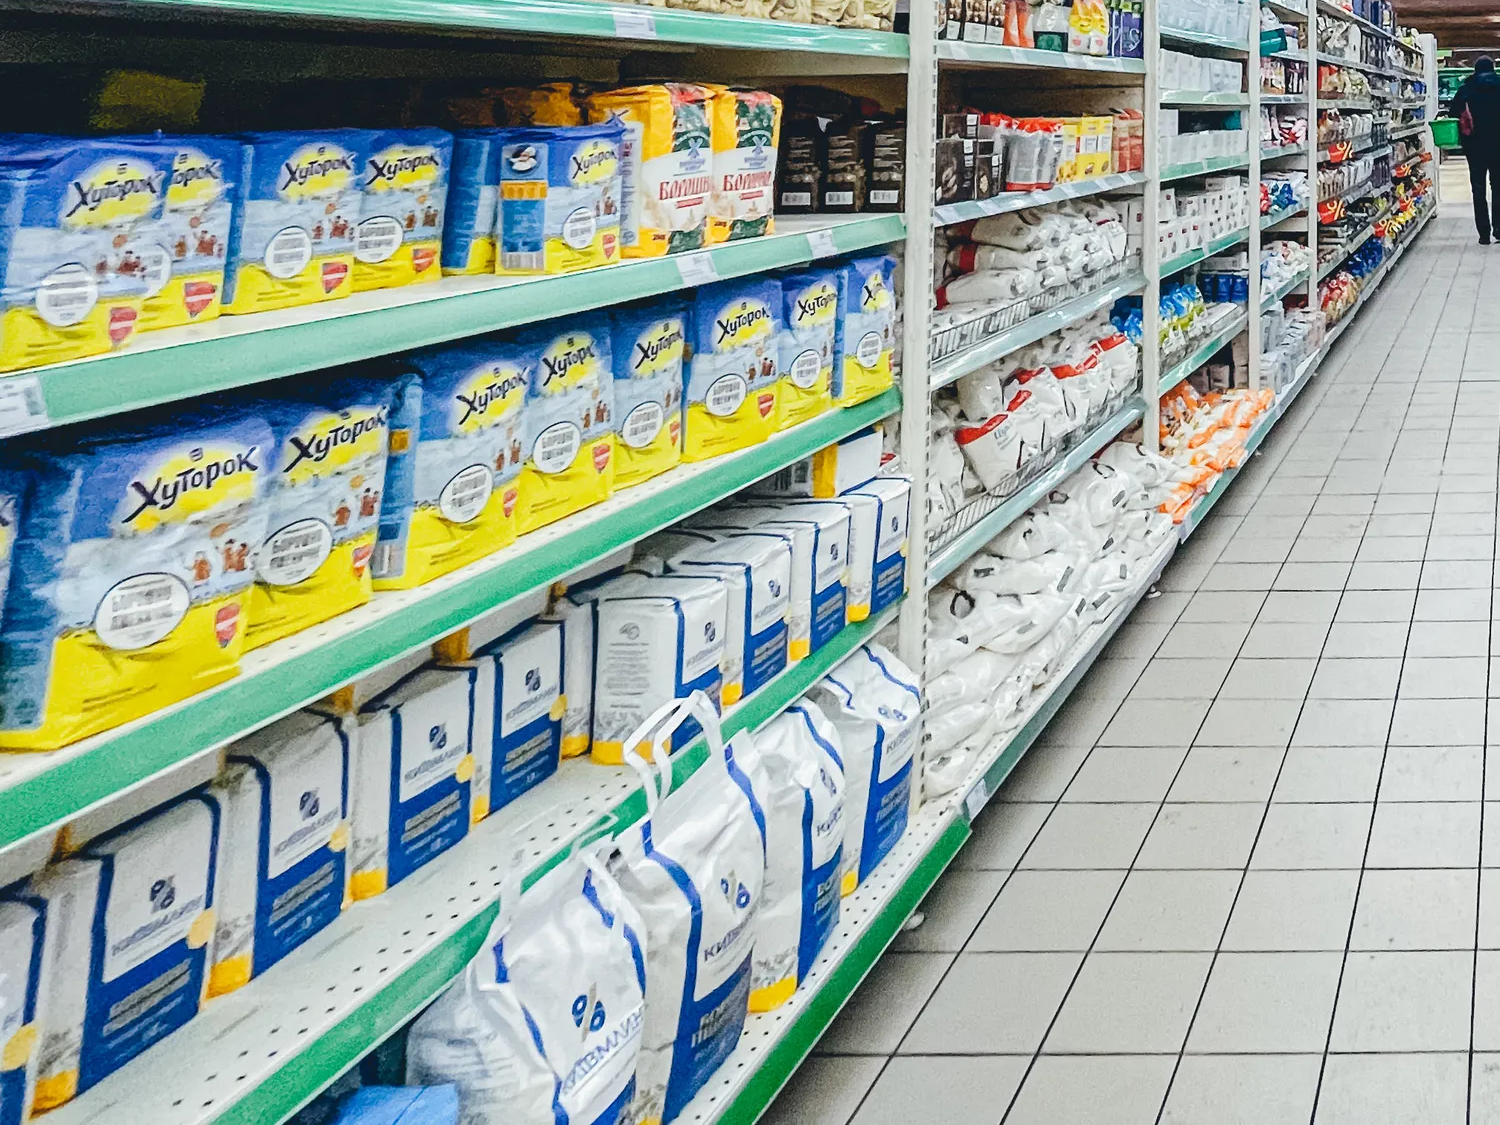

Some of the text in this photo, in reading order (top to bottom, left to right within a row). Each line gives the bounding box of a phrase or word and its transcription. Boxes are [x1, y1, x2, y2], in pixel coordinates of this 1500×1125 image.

[281, 152, 356, 191] Хуторок
[365, 151, 441, 186] Хуторок
[65, 169, 165, 218] Хуторок
[716, 303, 771, 344] Хуторок
[456, 367, 531, 426] Хуторок
[283, 404, 390, 473] Хуторок
[121, 446, 261, 524] Хуторок
